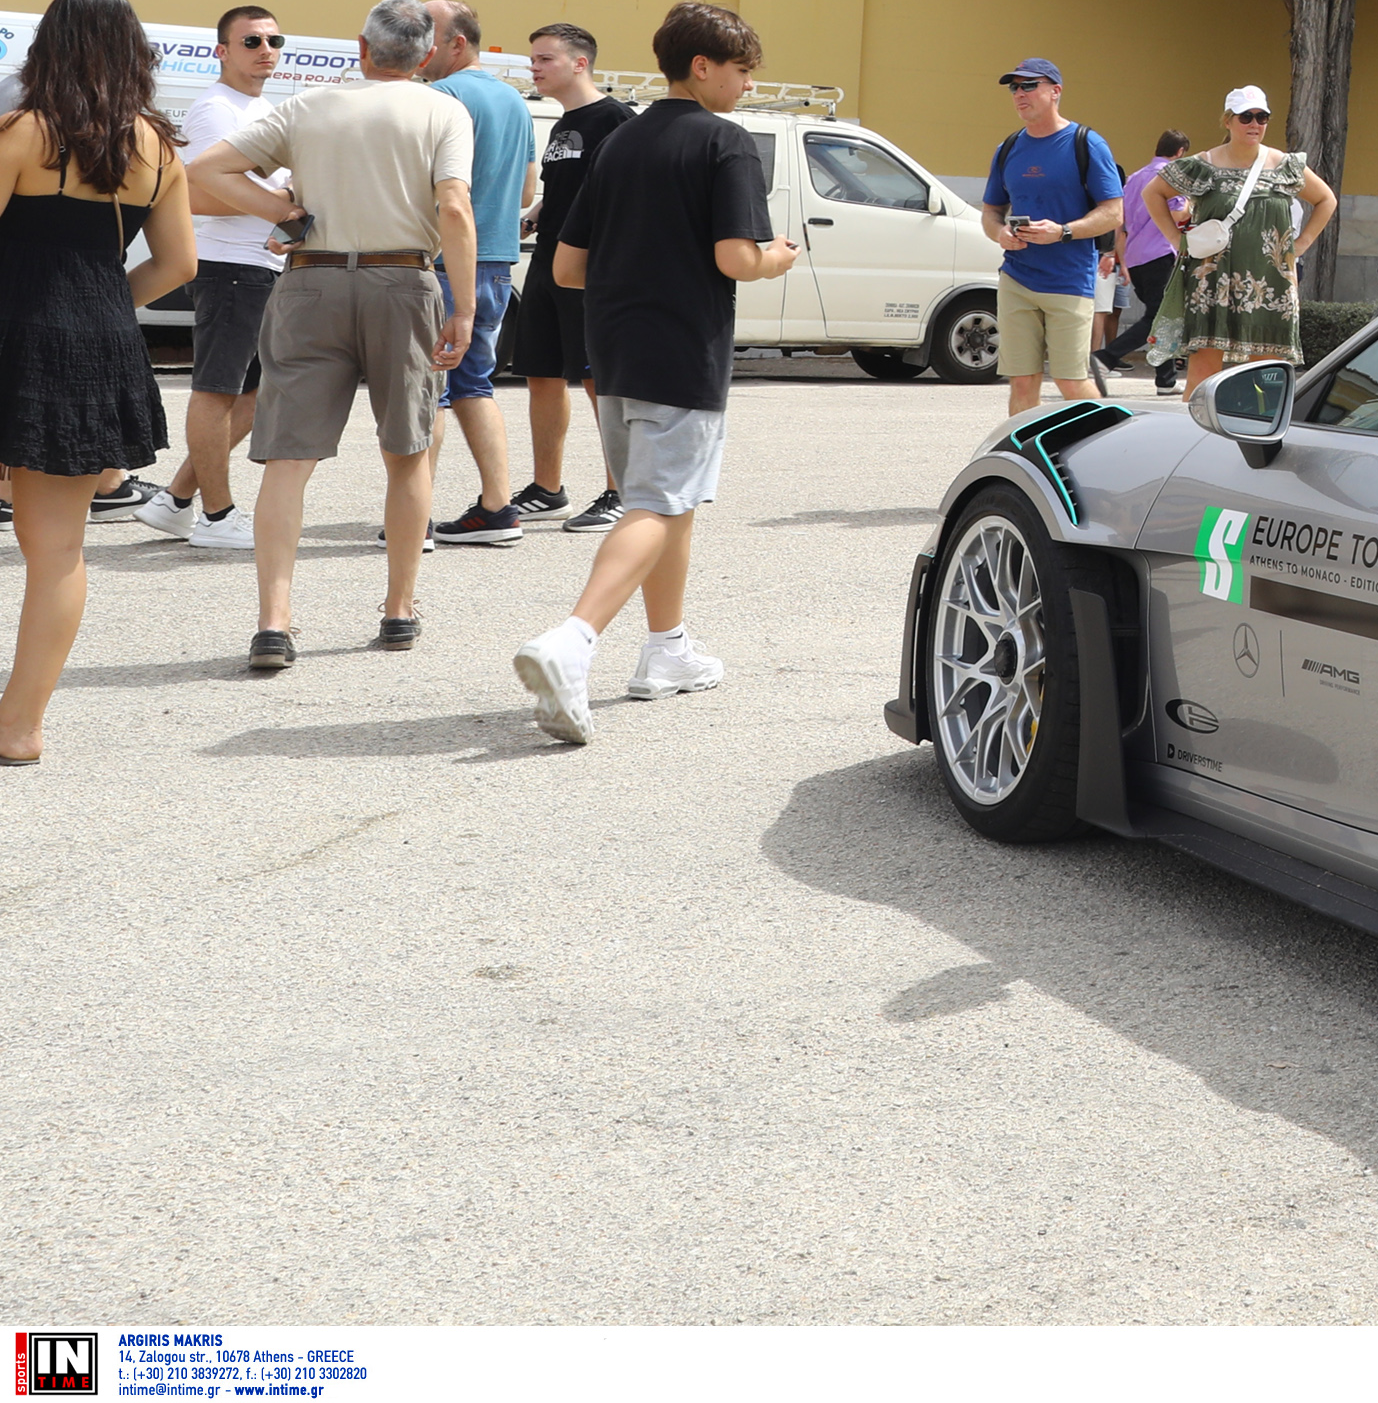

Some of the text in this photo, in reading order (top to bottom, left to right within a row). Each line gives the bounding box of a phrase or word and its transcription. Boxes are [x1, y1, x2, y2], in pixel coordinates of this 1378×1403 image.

[0, 27, 15, 39] PO
[161, 59, 221, 75] HÍCUL
[283, 52, 360, 68] TODOT
[1252, 515, 1344, 561] EUROPE
[1250, 554, 1284, 572] ATHENS
[1286, 562, 1298, 575] TO
[1301, 565, 1341, 585] MONACO
[1320, 663, 1360, 685] AMG
[1177, 749, 1223, 773] DRIVERSTIME
